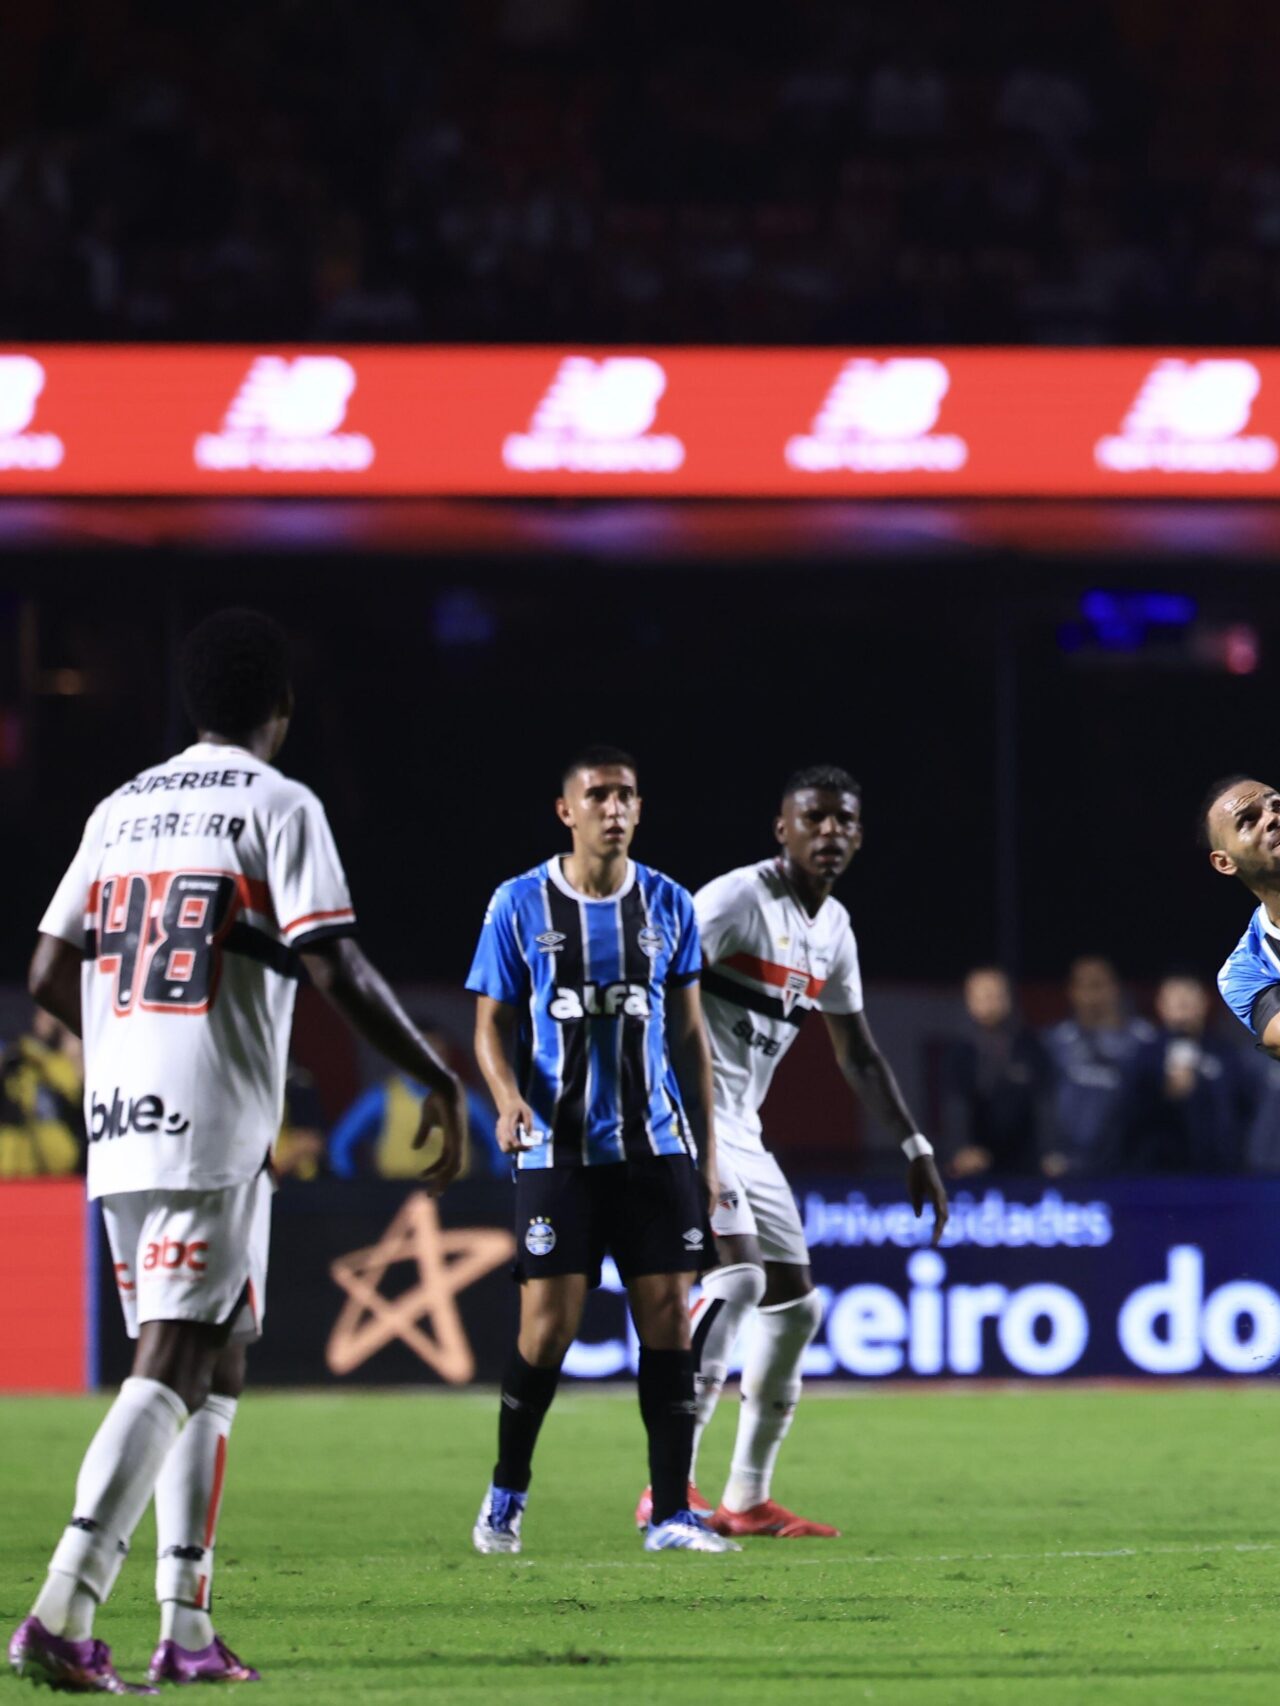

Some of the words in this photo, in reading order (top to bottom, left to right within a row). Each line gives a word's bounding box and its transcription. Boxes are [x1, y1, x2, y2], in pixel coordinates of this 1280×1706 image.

[121, 769, 259, 796] SUPERBET
[97, 869, 238, 1016] 48
[91, 1086, 165, 1143] blue
[144, 1235, 209, 1271] abc
